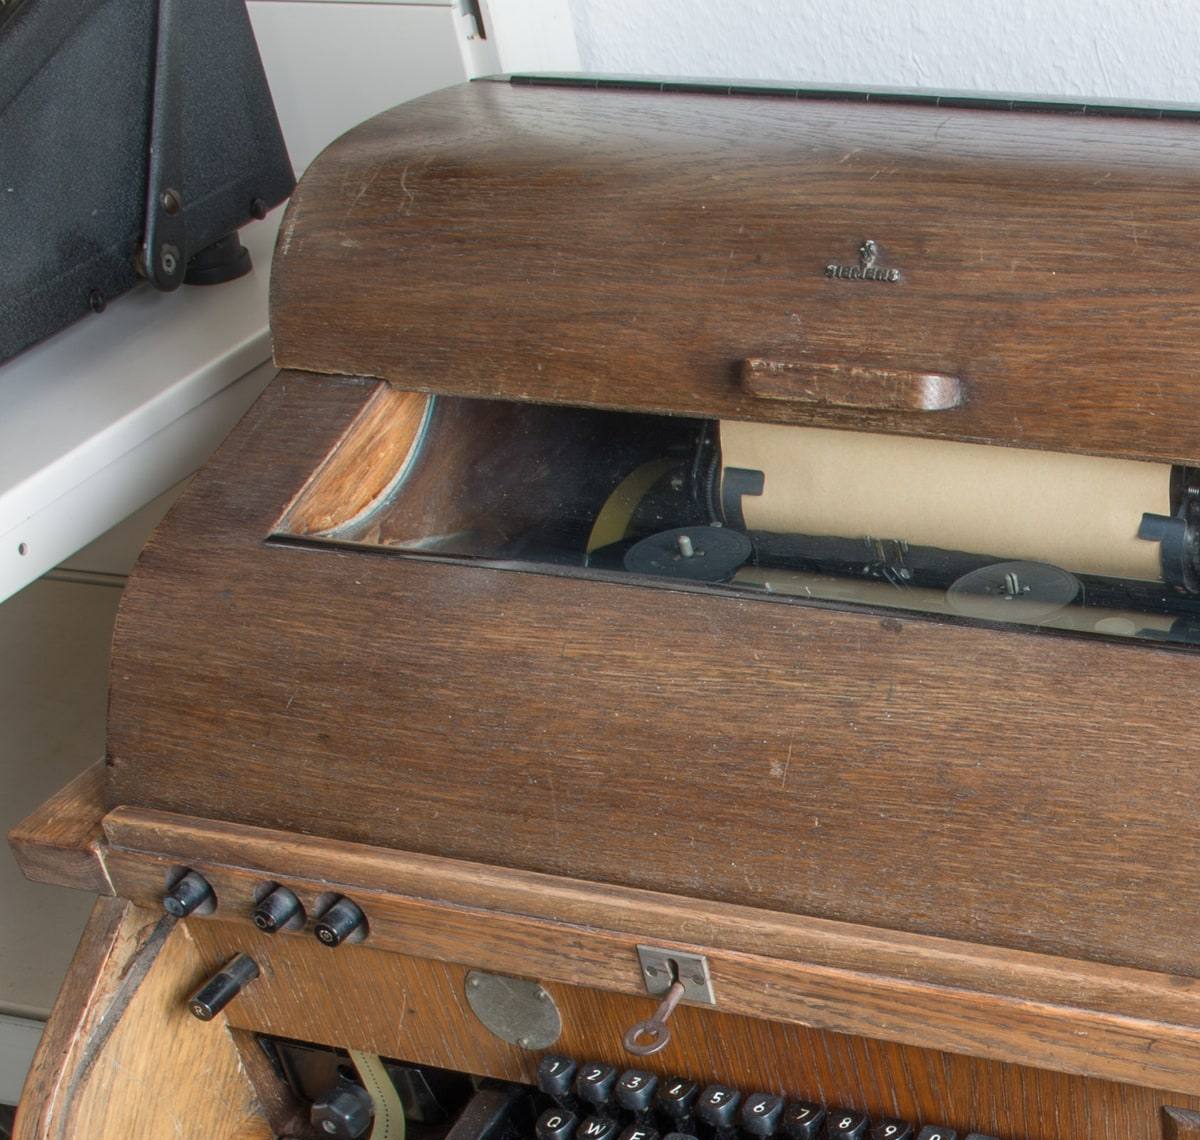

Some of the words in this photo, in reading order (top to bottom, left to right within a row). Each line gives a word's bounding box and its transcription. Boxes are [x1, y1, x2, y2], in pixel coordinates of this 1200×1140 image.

[550, 1062, 560, 1073] 1
[586, 1069, 601, 1081] 2
[626, 1076, 642, 1089] 3
[710, 1091, 724, 1104] 5
[753, 1101, 766, 1113] 6
[796, 1108, 810, 1120] 7
[838, 1117, 852, 1129] 8
[884, 1125, 897, 1137] 9
[546, 1116, 562, 1128] Q
[587, 1122, 606, 1136] W
